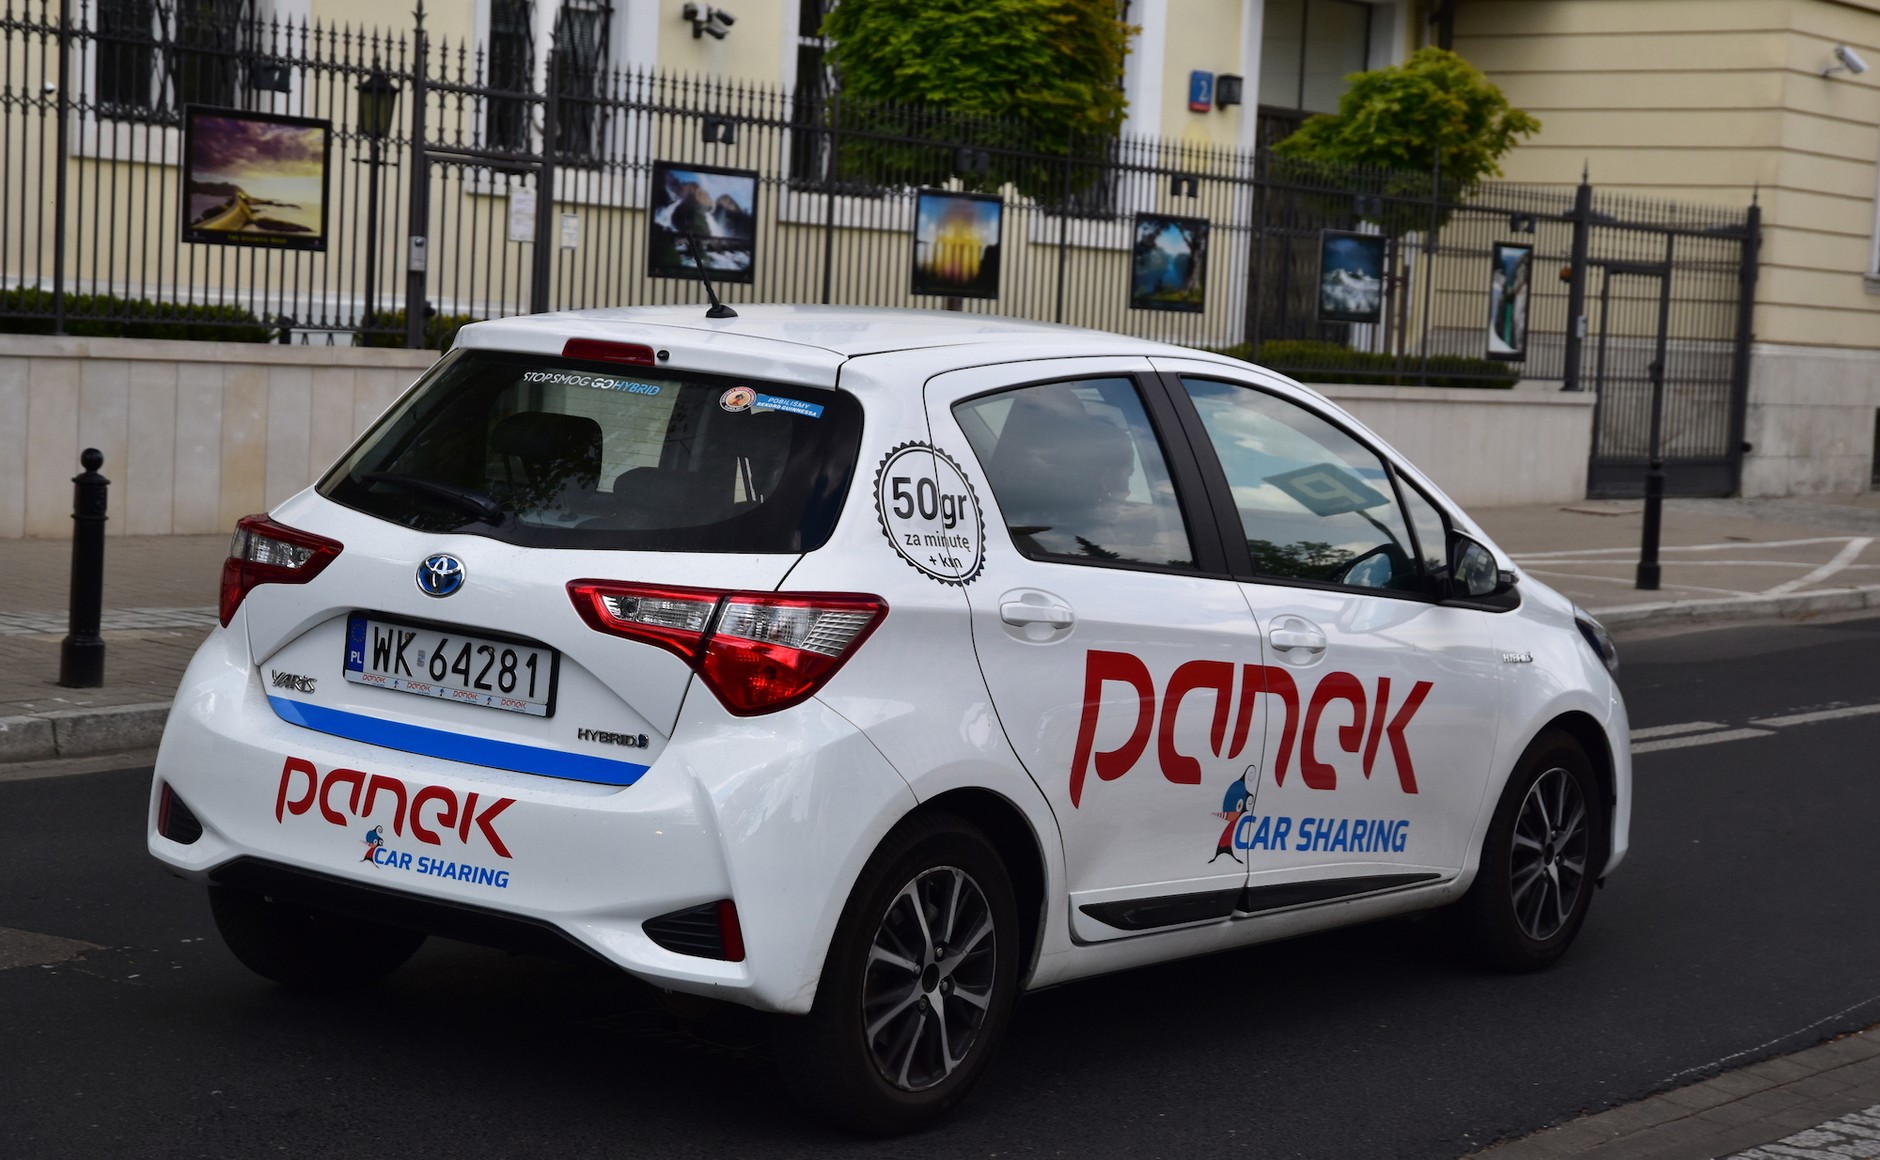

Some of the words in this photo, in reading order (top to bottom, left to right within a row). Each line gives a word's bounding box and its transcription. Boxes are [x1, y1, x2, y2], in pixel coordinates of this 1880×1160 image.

[1199, 80, 1209, 102] 2
[904, 534, 921, 546] za
[924, 530, 971, 552] minutę
[938, 553, 963, 569] km
[350, 650, 362, 664] PL
[373, 626, 417, 677] WK
[429, 638, 538, 698] 64281
[577, 727, 638, 748] HYBRID
[1069, 649, 1434, 810] panek
[275, 755, 518, 860] panek
[1234, 815, 1292, 851] CAR
[1296, 817, 1410, 853] SHARING
[374, 847, 413, 870] CAR
[416, 856, 510, 889] SHARING
